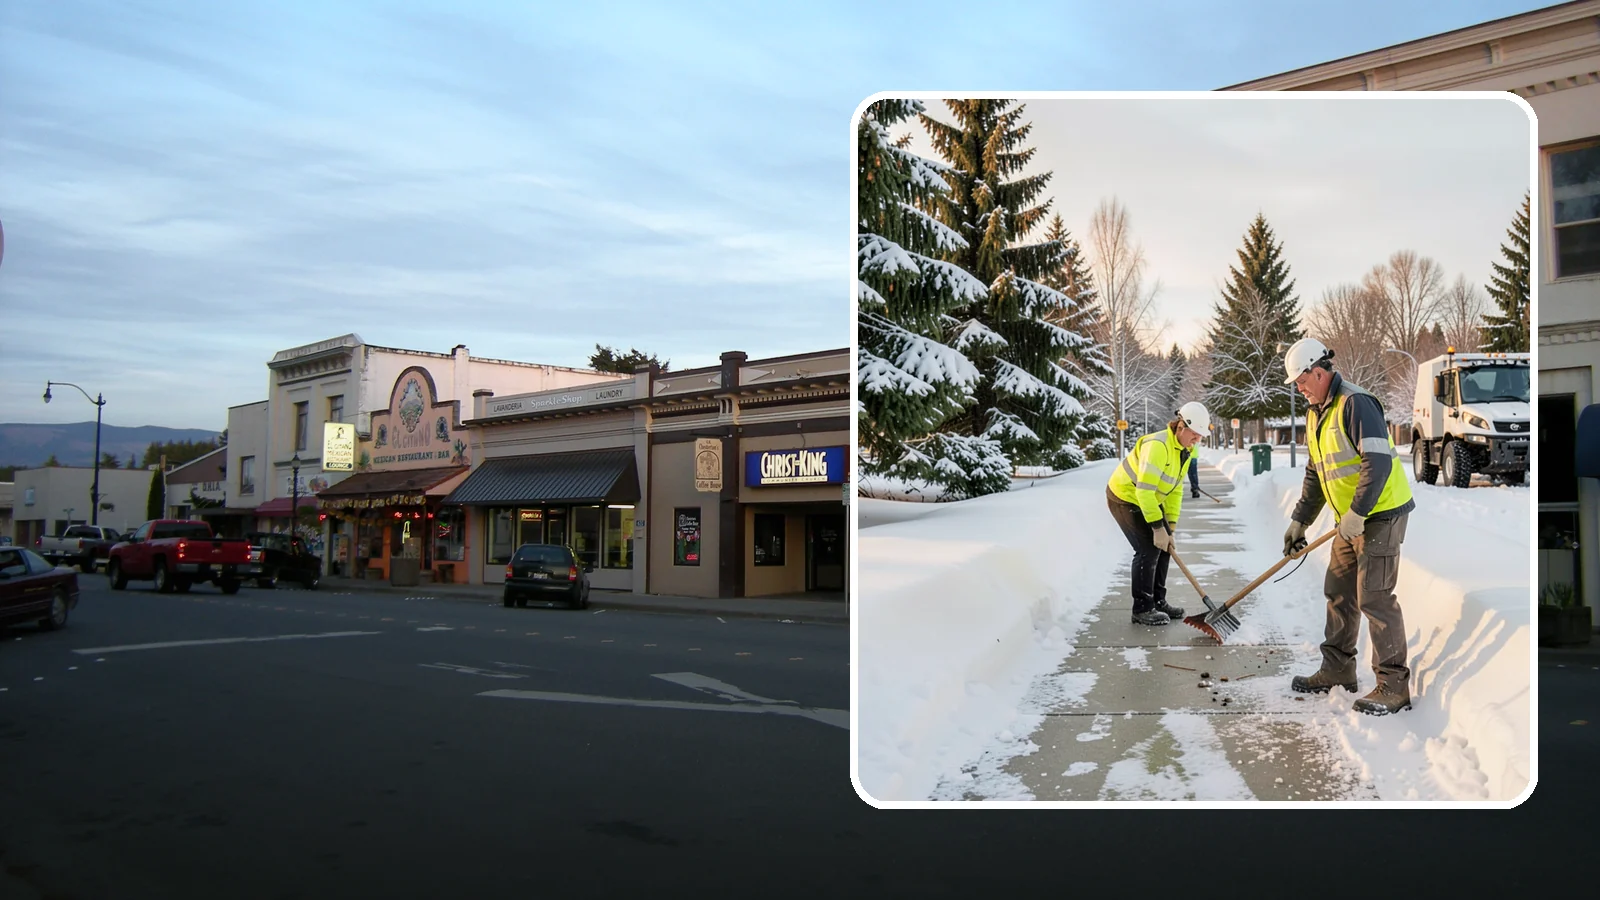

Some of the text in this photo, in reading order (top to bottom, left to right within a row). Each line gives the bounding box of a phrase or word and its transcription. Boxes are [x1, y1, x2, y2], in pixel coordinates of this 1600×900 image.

[596, 389, 624, 400] LAUNDRY
[562, 395, 582, 405] Shop
[493, 402, 523, 412] LAVANDERIA
[397, 452, 433, 462] RESTAURANT
[438, 450, 450, 459] BAR
